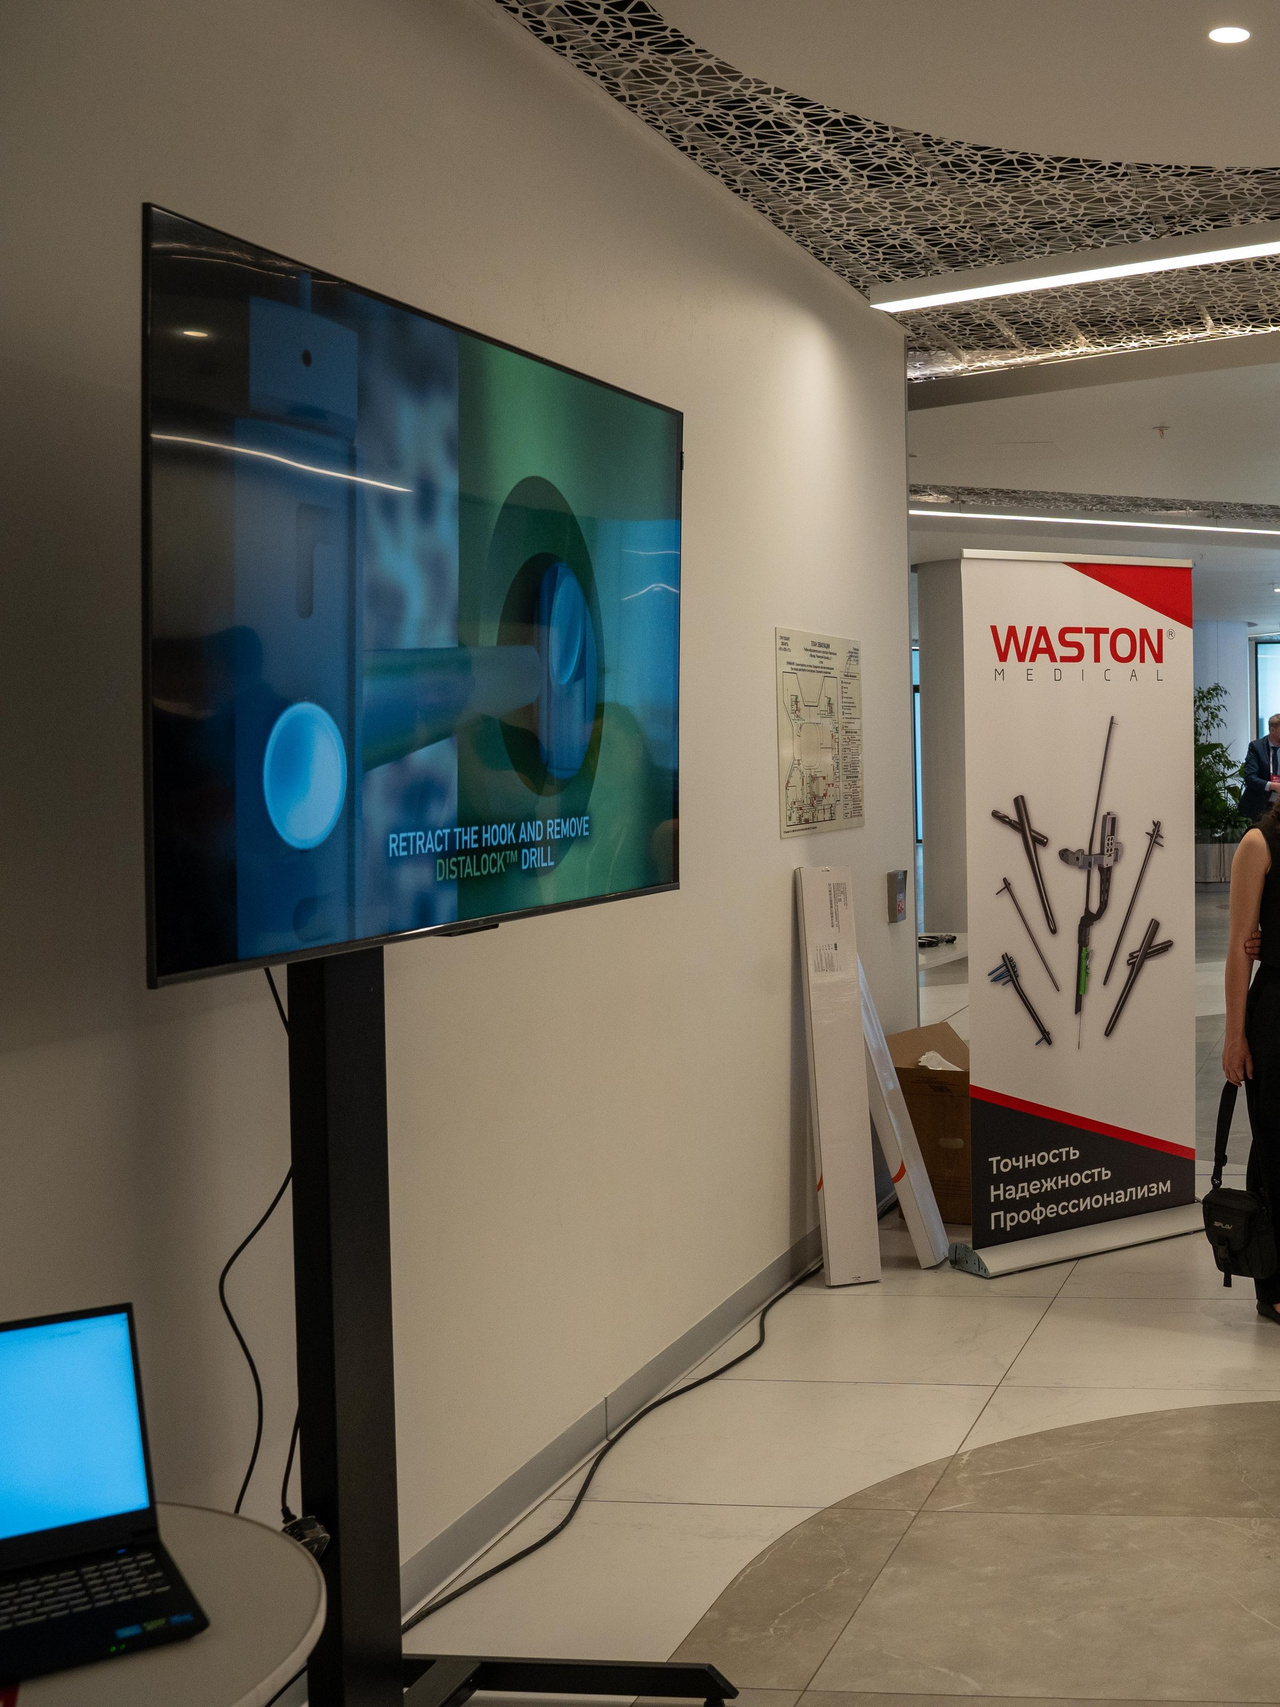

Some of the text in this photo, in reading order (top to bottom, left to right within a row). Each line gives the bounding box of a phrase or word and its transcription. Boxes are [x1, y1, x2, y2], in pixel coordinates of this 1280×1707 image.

[994, 668, 1163, 682] MEDICAL
[389, 816, 590, 857] RETRACT THE HOOK AND REMOVE
[522, 846, 554, 870] DRILL
[989, 1146, 1080, 1174] Точность
[990, 1166, 1112, 1202] Надежность
[990, 1180, 1171, 1231] Профессионализм
